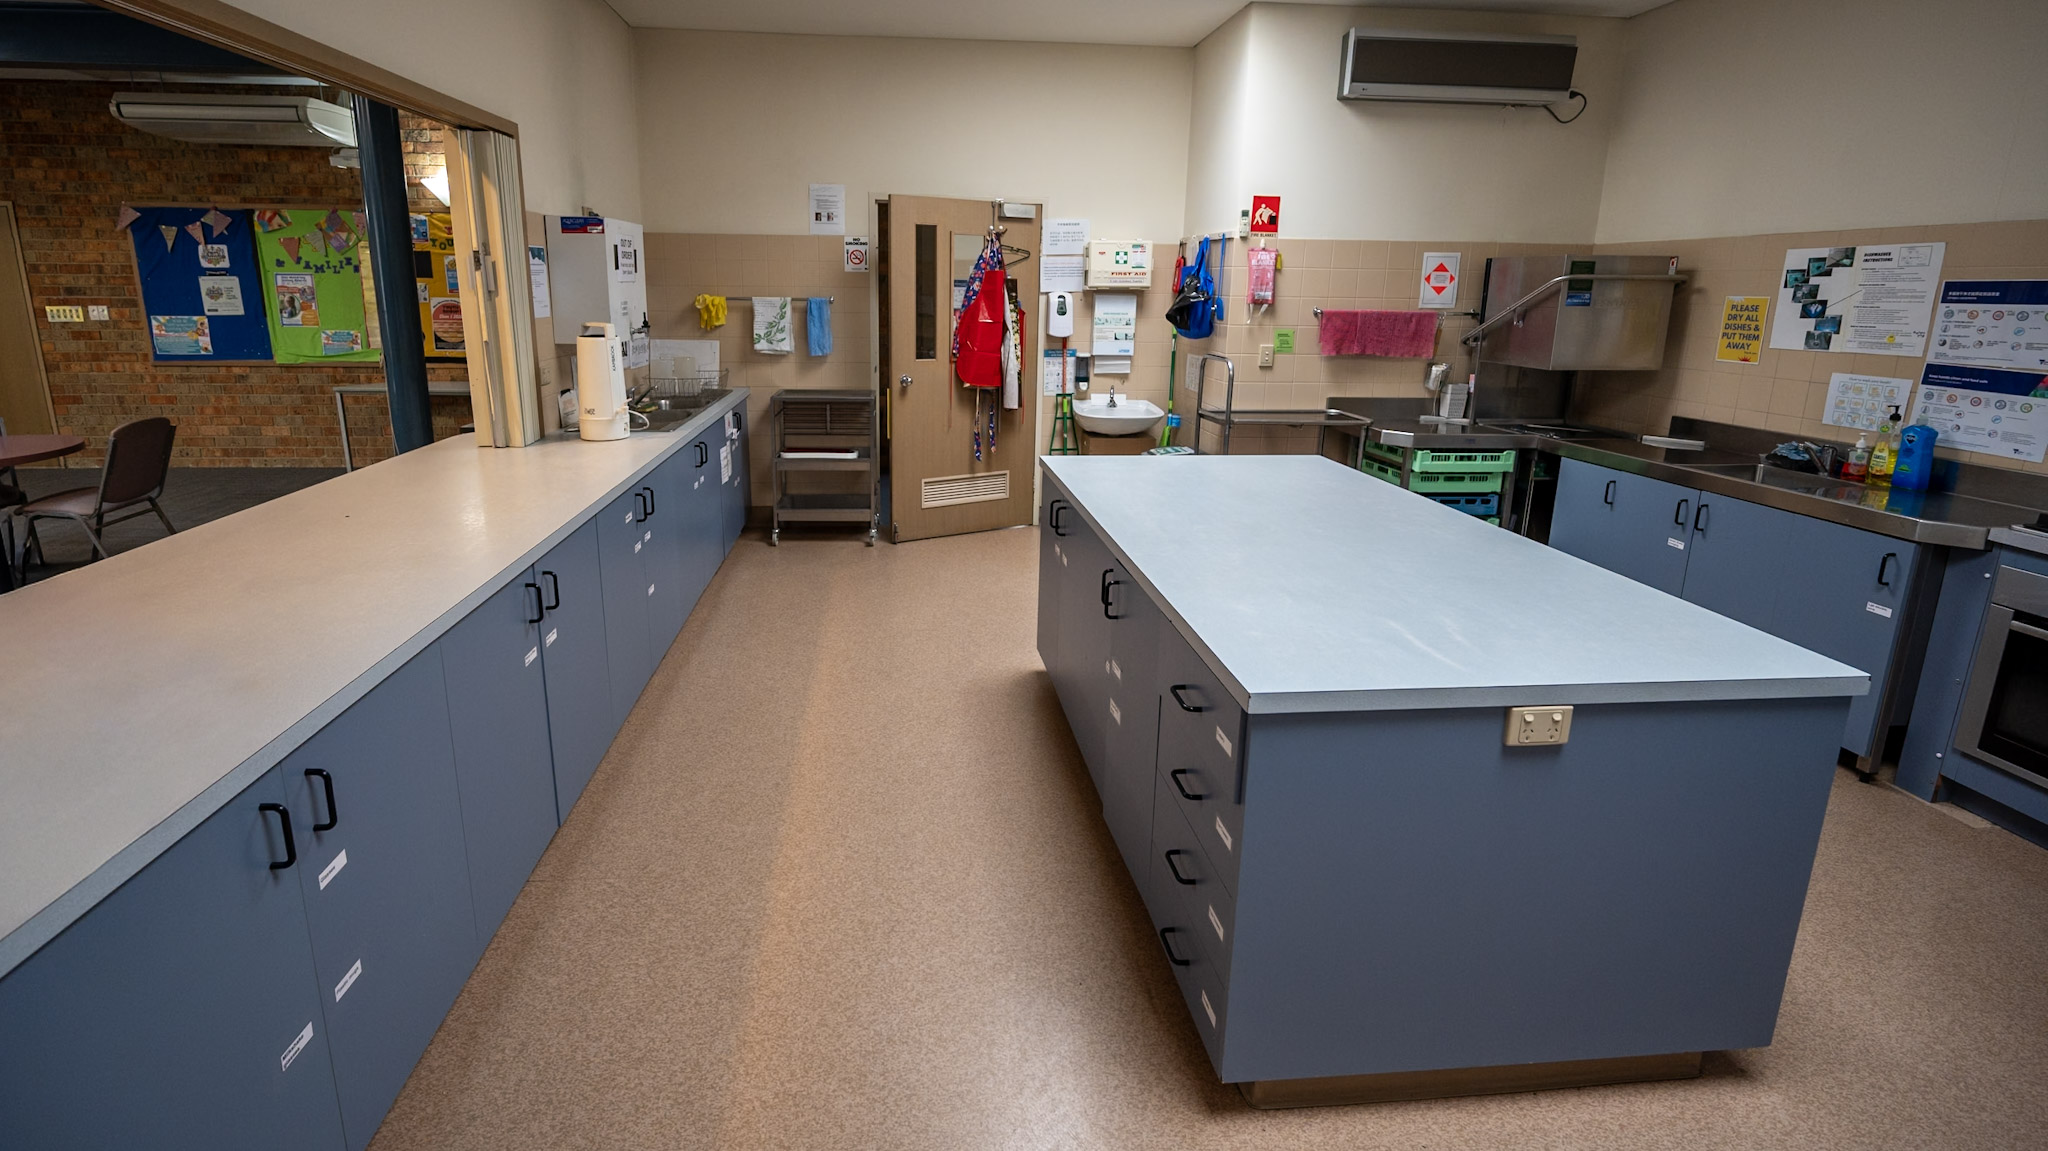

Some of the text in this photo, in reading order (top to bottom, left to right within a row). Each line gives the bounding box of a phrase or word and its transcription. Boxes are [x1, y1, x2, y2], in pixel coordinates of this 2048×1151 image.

[1730, 304, 1760, 312] PLEASE
[1727, 313, 1759, 322] DRY ALL
[1724, 323, 1760, 332] DISHES &
[1721, 332, 1760, 341] PUT THEM
[1725, 341, 1752, 350] AWAY
